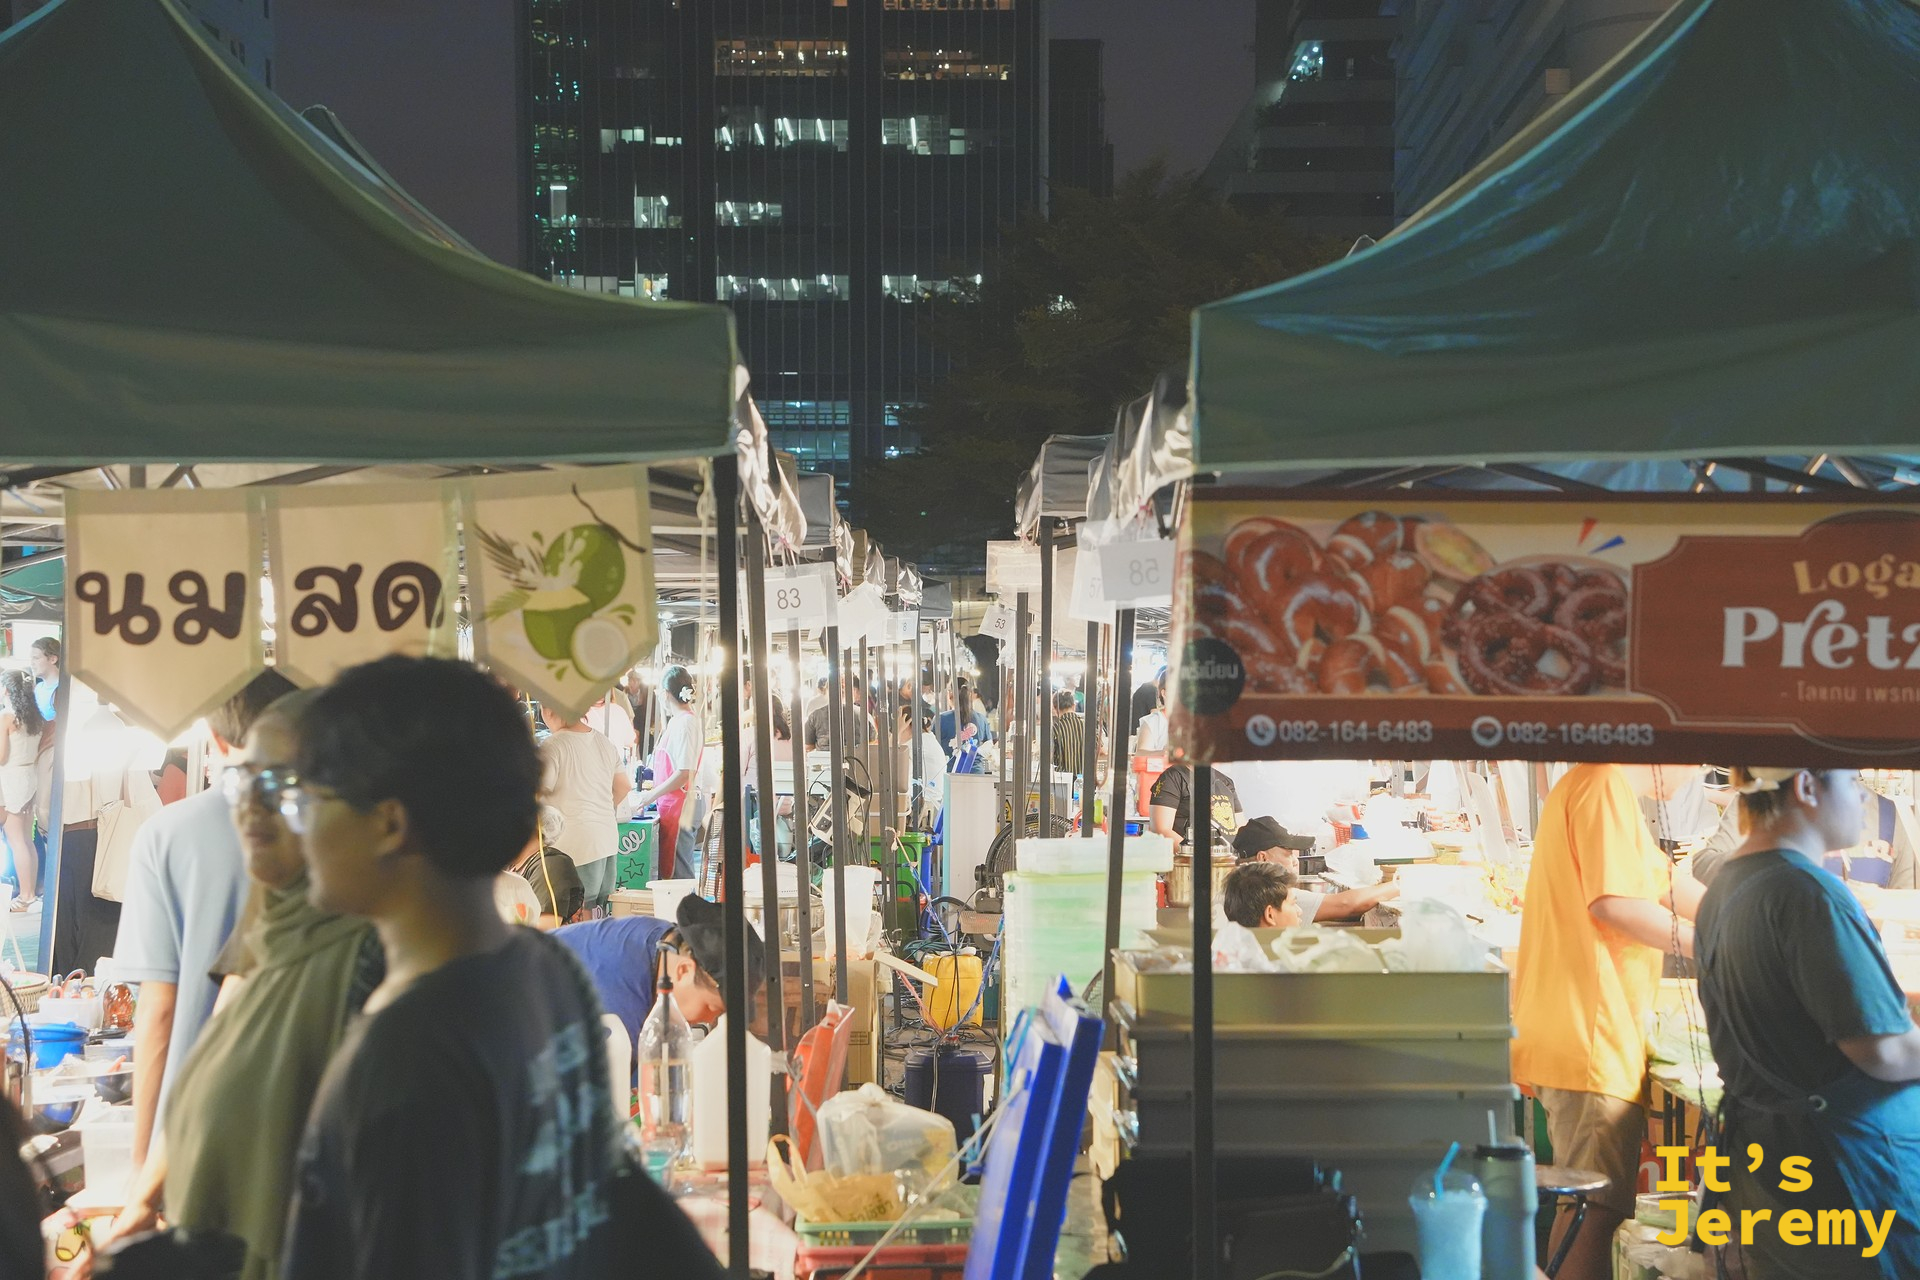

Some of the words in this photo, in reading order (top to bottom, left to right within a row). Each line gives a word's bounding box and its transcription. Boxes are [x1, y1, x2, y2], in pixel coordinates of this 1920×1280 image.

[1793, 553, 1920, 600] Loga
[75, 570, 246, 646] นม
[291, 560, 443, 636] สด
[777, 587, 801, 610] 83
[995, 618, 1006, 630] 53
[1279, 720, 1433, 743] 082-164-6483
[1507, 721, 1655, 746] 082-1646483
